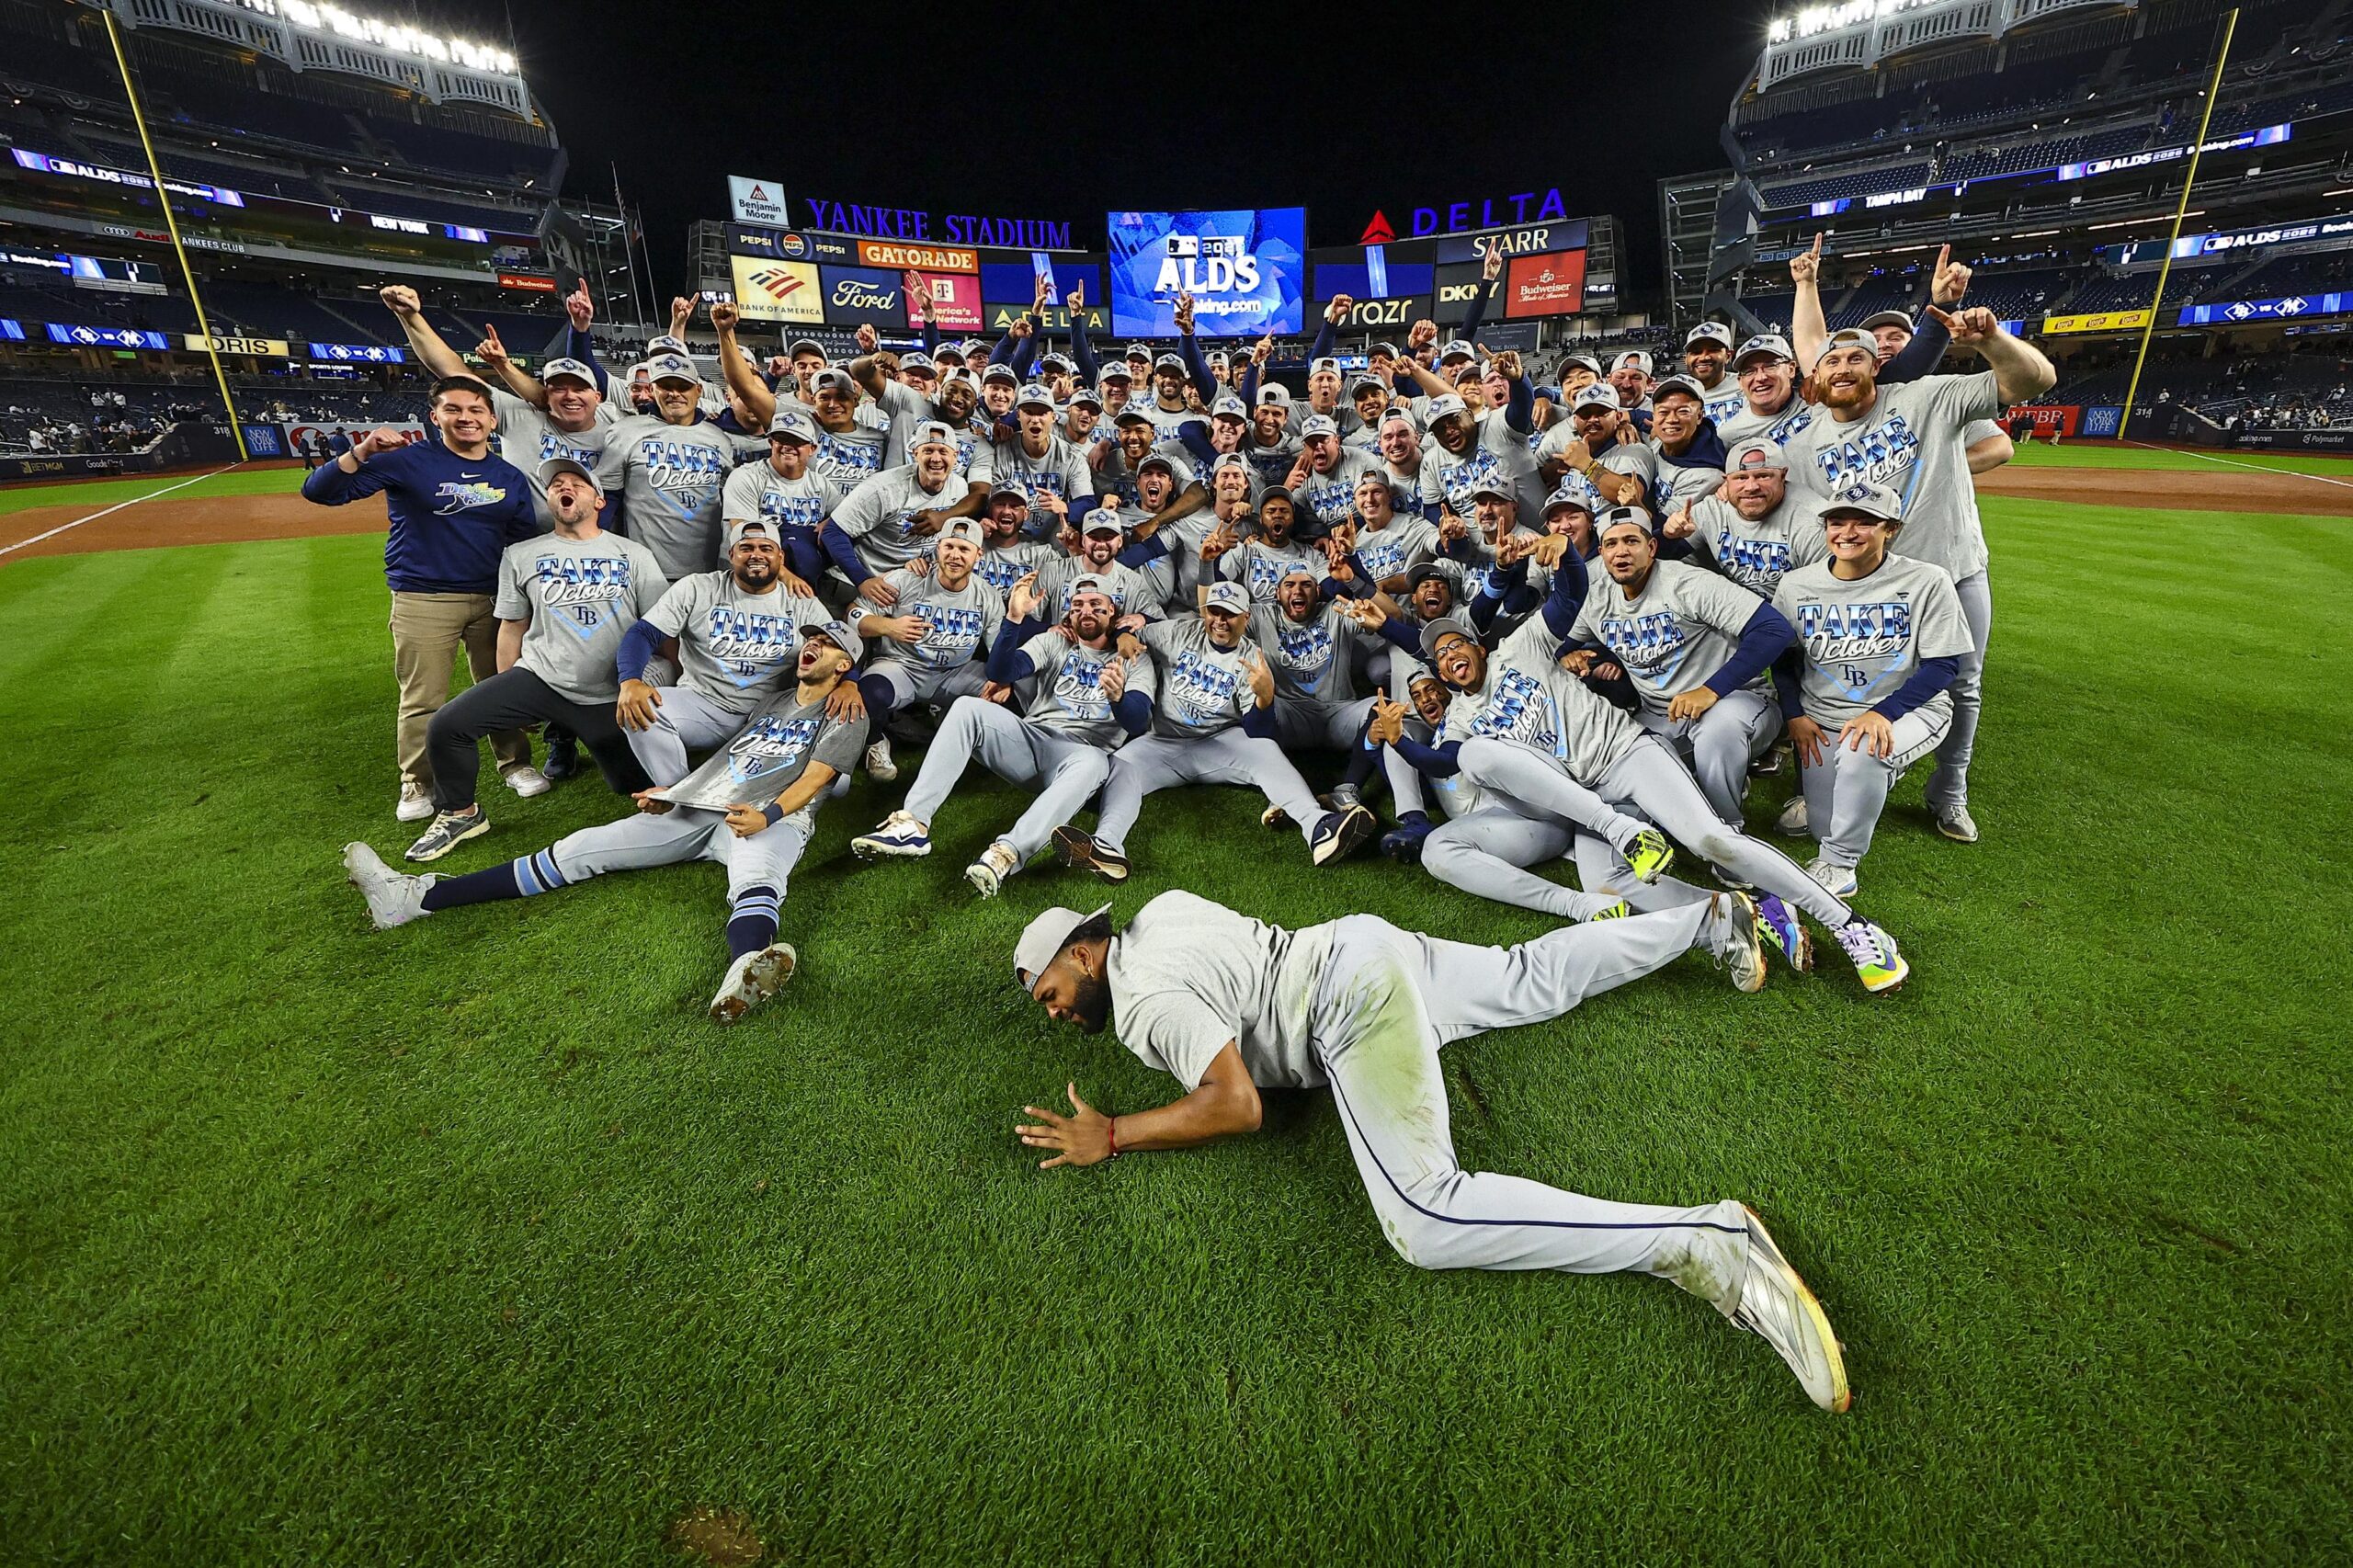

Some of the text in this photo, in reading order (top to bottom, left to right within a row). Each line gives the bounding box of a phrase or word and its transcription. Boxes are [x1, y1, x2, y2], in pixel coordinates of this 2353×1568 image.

[2110, 152, 2153, 170] ALDS
[2187, 136, 2255, 155] Boking.com
[77, 166, 121, 183] ALDS
[154, 180, 214, 199] Boking.com
[739, 199, 781, 213] Benjamin
[1865, 187, 1927, 209] TAMPA BAY
[745, 209, 776, 221] Moore
[1413, 188, 1565, 237] DELTA
[370, 215, 430, 235] NEW YORK
[805, 199, 1070, 249] YANKEE STADIUM
[181, 236, 219, 249] ANKEES
[222, 240, 245, 254] CLUB
[740, 234, 772, 246] PEPSI
[784, 241, 804, 249] PEPSI
[2232, 230, 2282, 248] ALDS
[2322, 222, 2353, 234] Book
[815, 244, 846, 255] PEPSI
[866, 245, 972, 269] GATORADE
[516, 279, 554, 290] Budweiser
[1154, 256, 1260, 293] ALDS
[832, 280, 895, 310] Ford
[936, 283, 949, 298] T
[1520, 282, 1572, 296] Budweiser
[739, 303, 765, 312] BANK
[780, 307, 821, 316] AMERICA
[936, 313, 981, 325] Network
[1351, 299, 1414, 325] razr
[2119, 313, 2141, 325] Lay's
[2055, 319, 2075, 330] Lay's
[2086, 316, 2107, 328] Lay's
[205, 337, 269, 354] ORIS
[2087, 416, 2115, 426] YORK
[2093, 410, 2115, 419] NEW
[2135, 408, 2153, 416] 314
[249, 427, 269, 437] NEW
[1768, 412, 1812, 448] KE
[2089, 424, 2111, 432] LIFE
[247, 434, 276, 445] YORK
[252, 443, 275, 452] LIFE
[1817, 416, 1920, 483] TAKE
[2238, 434, 2273, 445] ooking.com
[2311, 434, 2345, 444] Polymarket
[540, 435, 603, 472] TAK
[643, 441, 721, 474] TAKE
[817, 434, 881, 472] TAKE
[30, 461, 64, 472] BETMGM
[647, 462, 721, 489] October
[815, 456, 876, 480] Octobe
[1831, 443, 1920, 489] October
[436, 482, 490, 497] DEVIL
[464, 487, 506, 506] RAYS
[676, 491, 697, 508] TB
[762, 492, 822, 526] TAKE
[1031, 510, 1044, 528] TB
[1316, 501, 1357, 524] Octobe
[1718, 531, 1792, 572] TAKE
[537, 558, 630, 587] TAKE
[1367, 557, 1405, 580] ctober
[540, 573, 626, 605] October
[573, 606, 597, 626] TB
[850, 608, 863, 619] 6
[913, 603, 983, 636] TAKE
[1798, 602, 1912, 639] TAKE
[709, 608, 794, 645] TAKE
[1601, 611, 1685, 648] TAKE
[708, 632, 793, 658] October
[916, 627, 981, 648] October
[1806, 627, 1911, 661] October
[933, 649, 949, 666] TB
[1279, 642, 1334, 668] October
[734, 660, 756, 677] TB
[1060, 649, 1103, 687] TAK
[1172, 651, 1238, 697] TAKE
[1301, 670, 1316, 684] TB
[1838, 664, 1870, 687] TB
[1054, 674, 1107, 702] Octobe
[1169, 675, 1229, 715] October
[1075, 703, 1090, 721] TB
[1471, 668, 1541, 735] TAKE
[1497, 684, 1548, 744] October
[744, 716, 822, 746] TAKE
[1536, 730, 1559, 747] TB
[743, 756, 763, 776] TB
